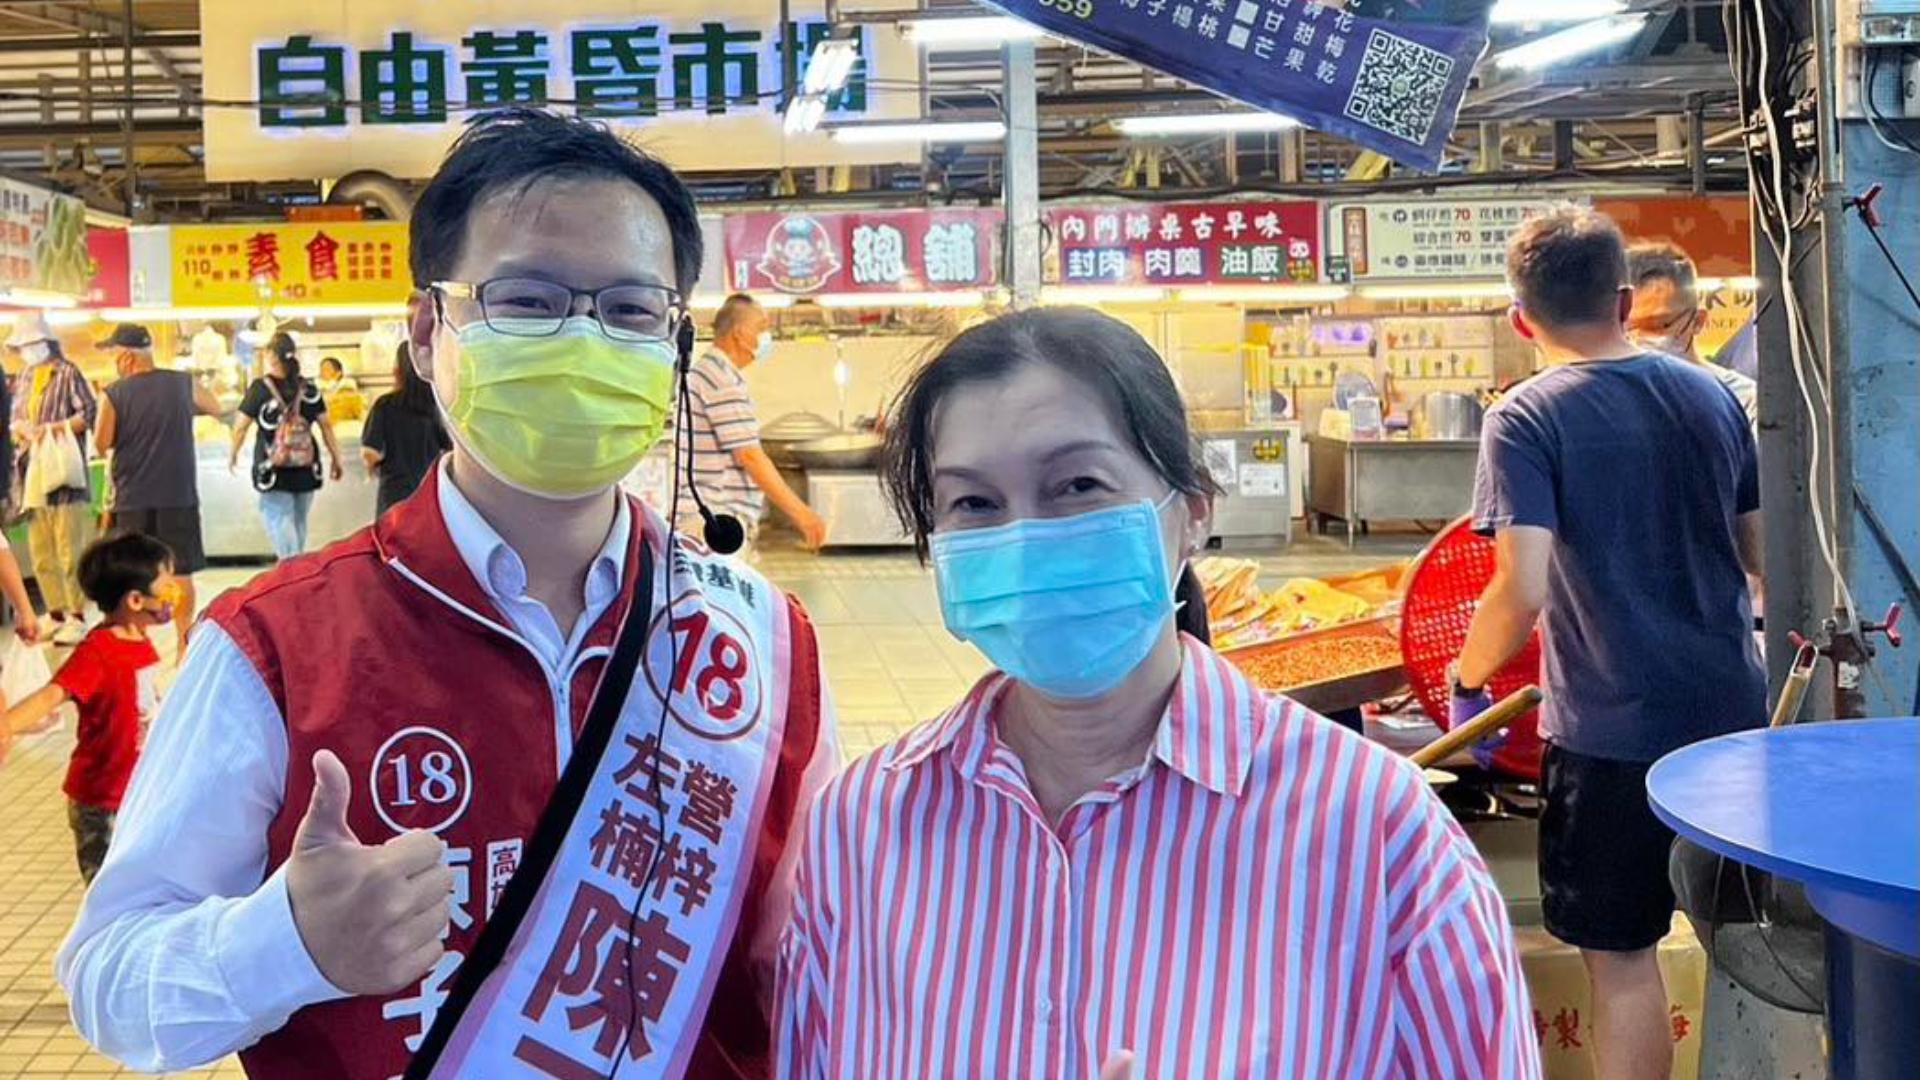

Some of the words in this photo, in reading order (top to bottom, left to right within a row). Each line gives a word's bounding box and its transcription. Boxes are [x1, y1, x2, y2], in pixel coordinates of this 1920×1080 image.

[1262, 9, 1346, 57] 甘甜梅
[1252, 35, 1338, 85] 芒果乾
[1455, 208, 1470, 220] 70
[1456, 231, 1470, 243] 70
[183, 259, 211, 276] 110
[247, 230, 339, 281] 素食
[1068, 250, 1126, 278] 封肉
[1221, 246, 1280, 275] 油飯
[667, 611, 748, 720] 18
[387, 751, 457, 807] 18
[612, 732, 738, 845] 左營
[589, 799, 718, 916] 楠梓
[513, 880, 691, 1080] 陳
